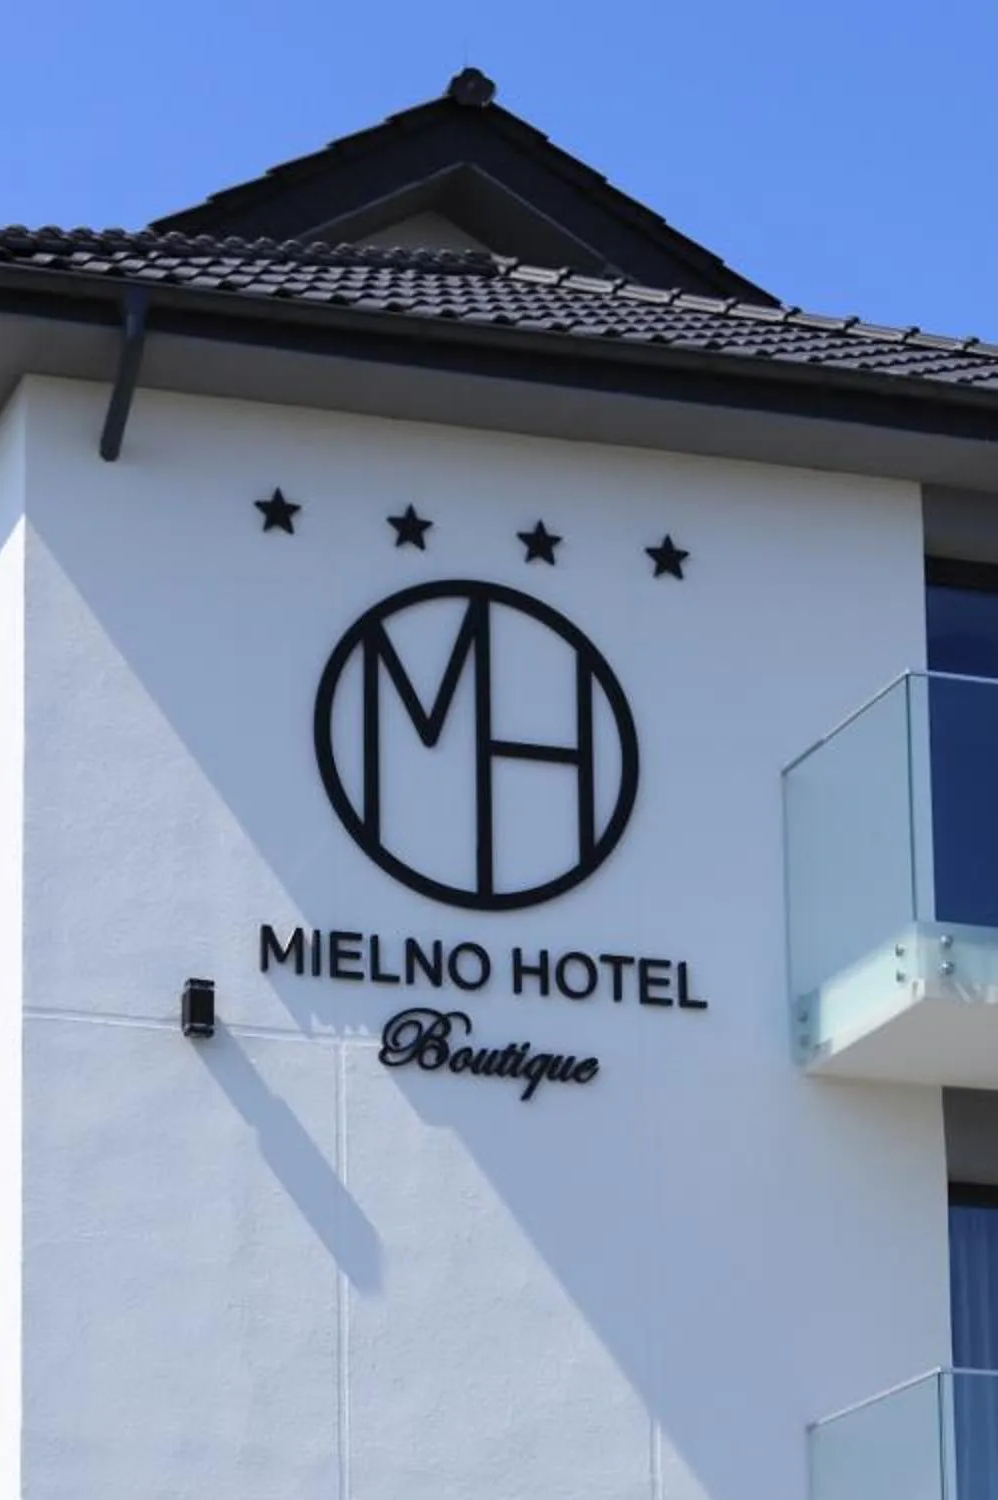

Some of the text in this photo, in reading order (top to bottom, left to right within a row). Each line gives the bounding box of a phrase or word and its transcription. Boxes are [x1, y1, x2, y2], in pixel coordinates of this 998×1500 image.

[360, 595, 597, 900] MH
[259, 924, 708, 1010] MIELNO HOTEL
[377, 1006, 600, 1102] Boutique
